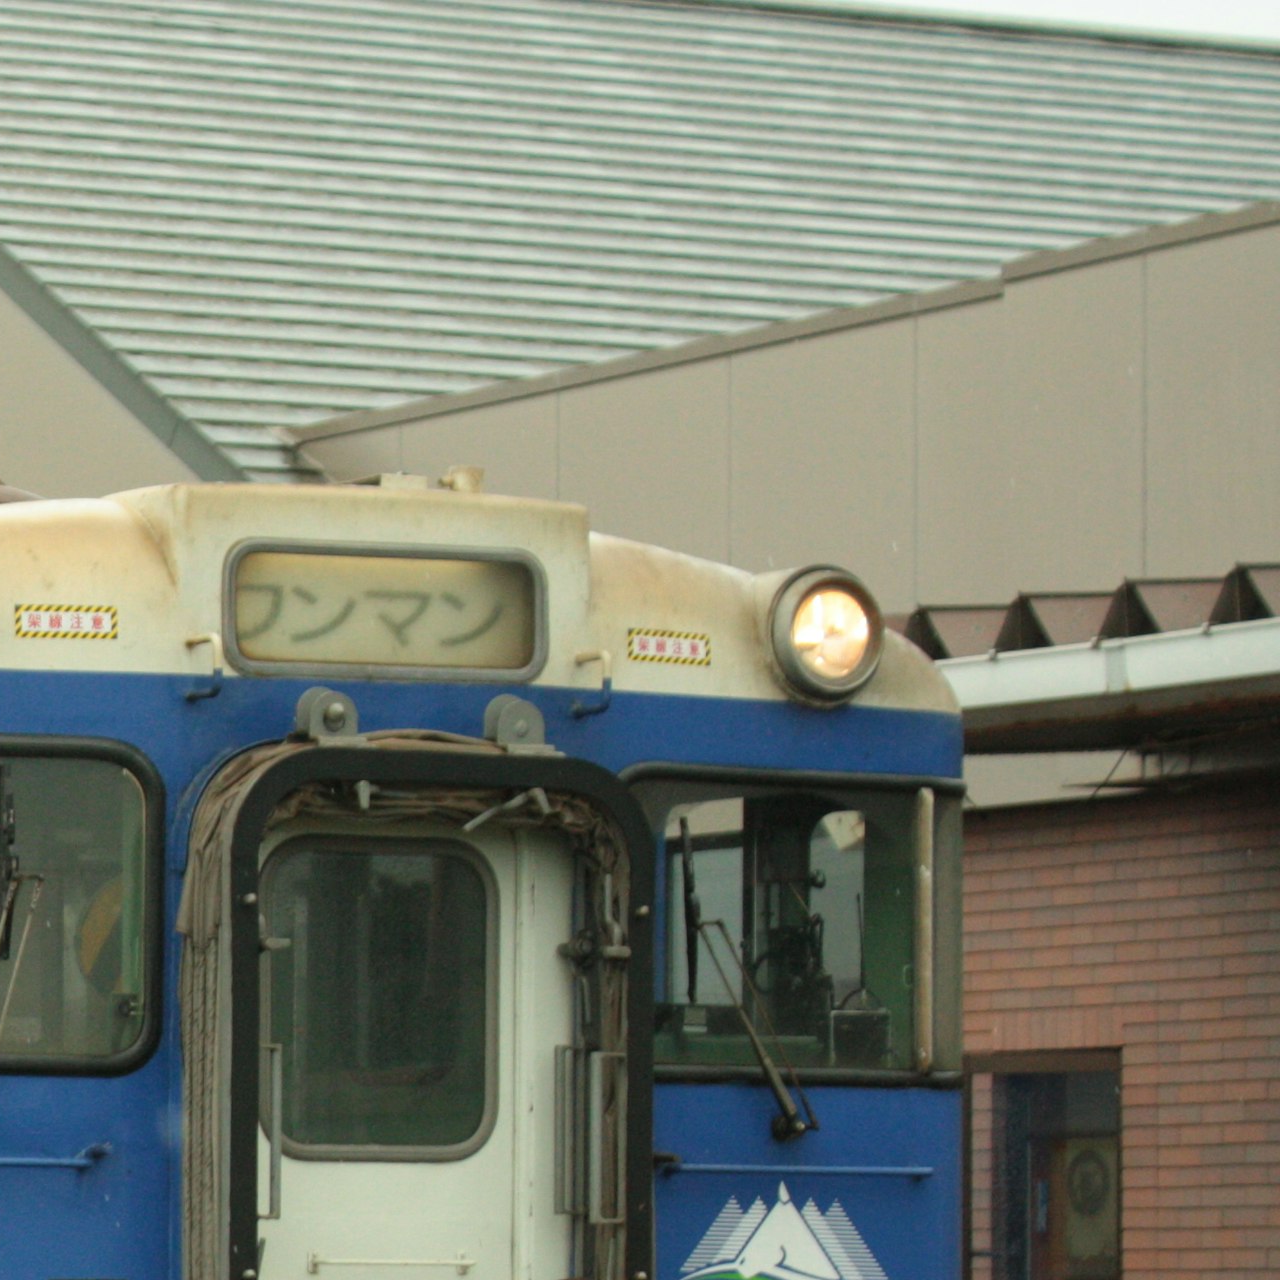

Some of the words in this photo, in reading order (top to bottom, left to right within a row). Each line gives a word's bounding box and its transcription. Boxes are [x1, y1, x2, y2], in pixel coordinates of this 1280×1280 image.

[27, 613, 105, 630] 架線注意
[638, 637, 700, 657] 架線注意
